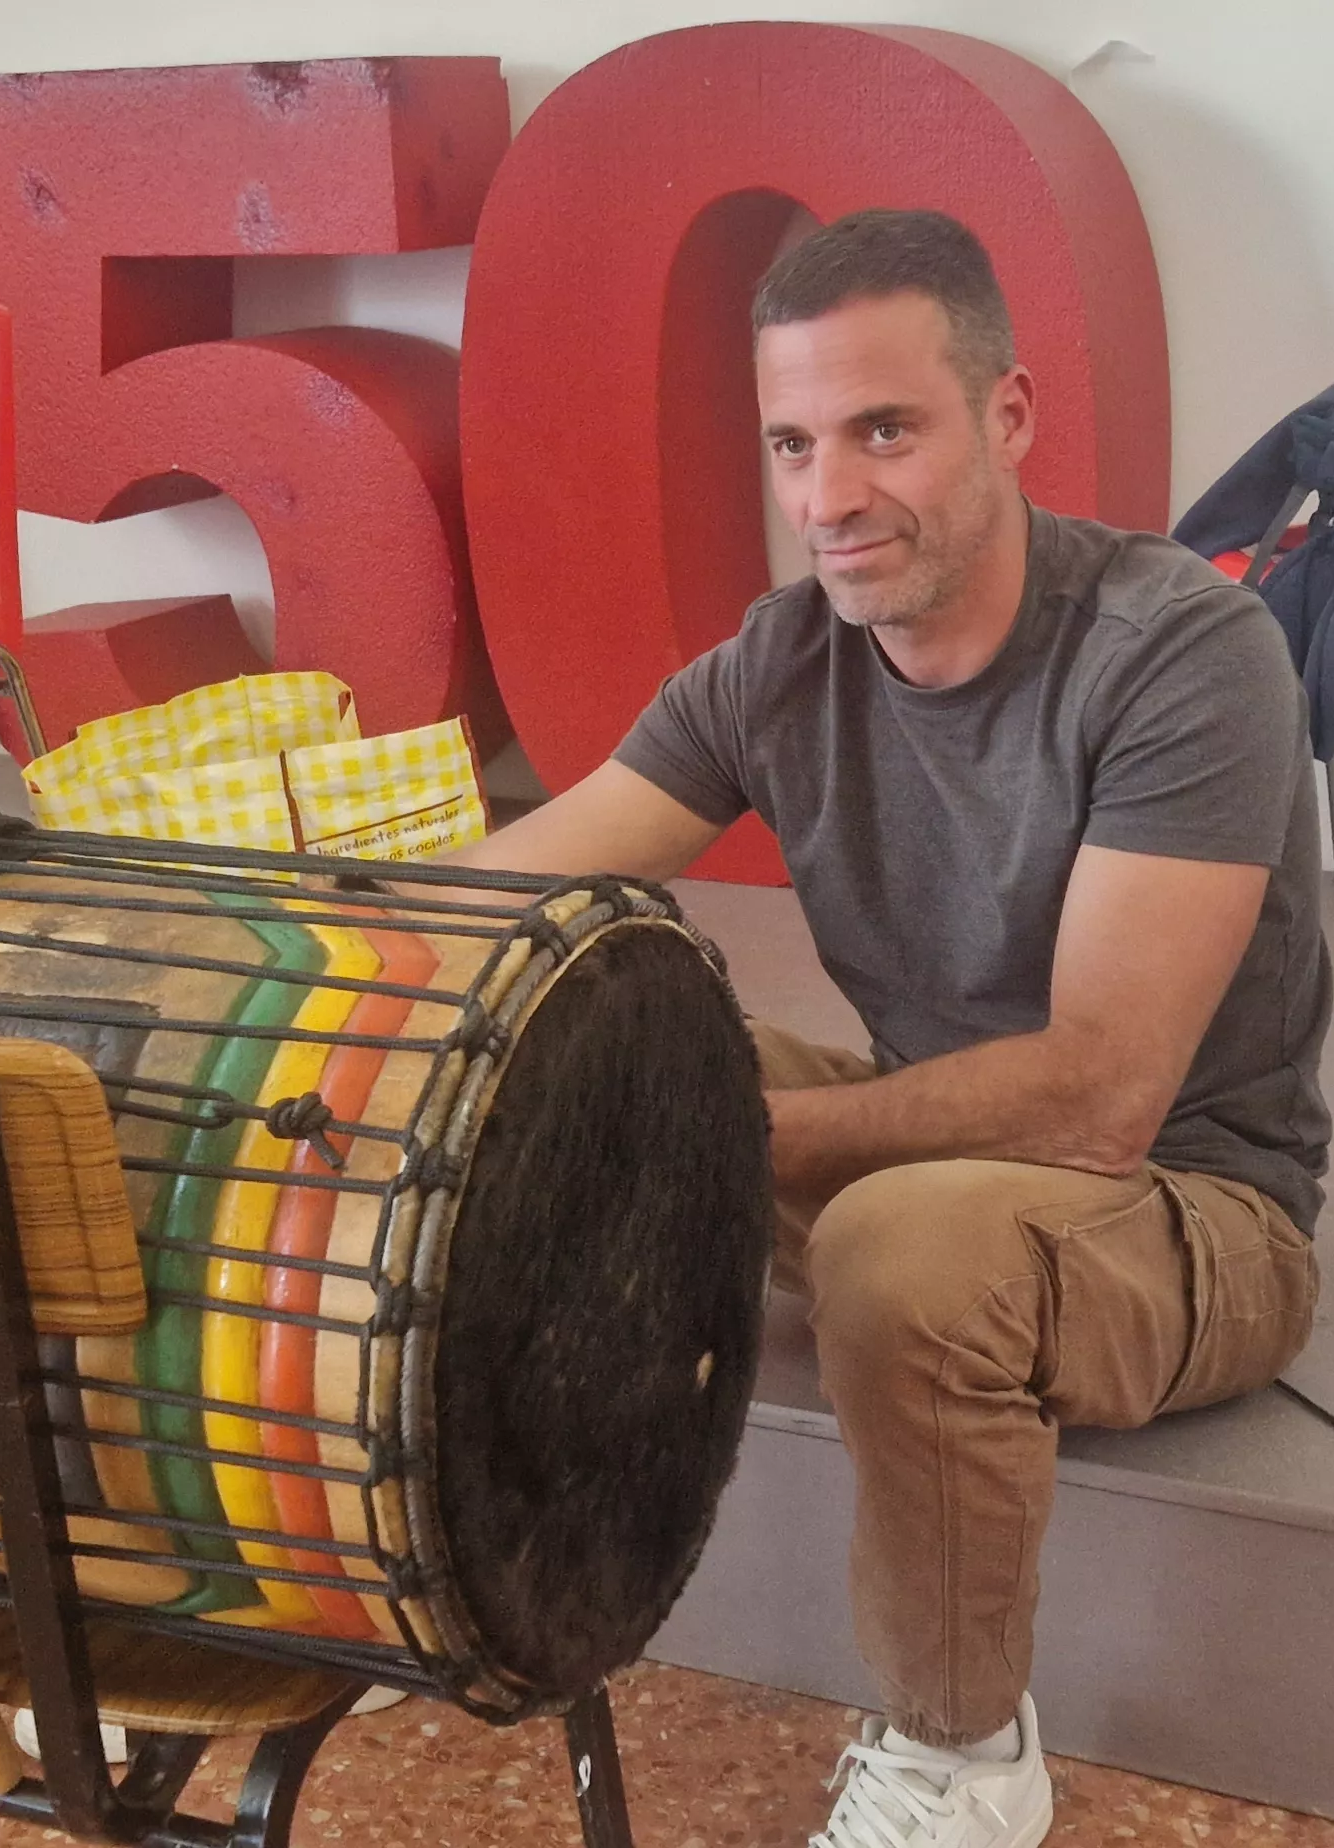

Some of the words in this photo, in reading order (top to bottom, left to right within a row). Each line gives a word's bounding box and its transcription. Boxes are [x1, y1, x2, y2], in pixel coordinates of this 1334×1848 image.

[317, 829, 399, 857] Ingredientes
[404, 808, 460, 834] naturales
[407, 832, 456, 856] cocidos
